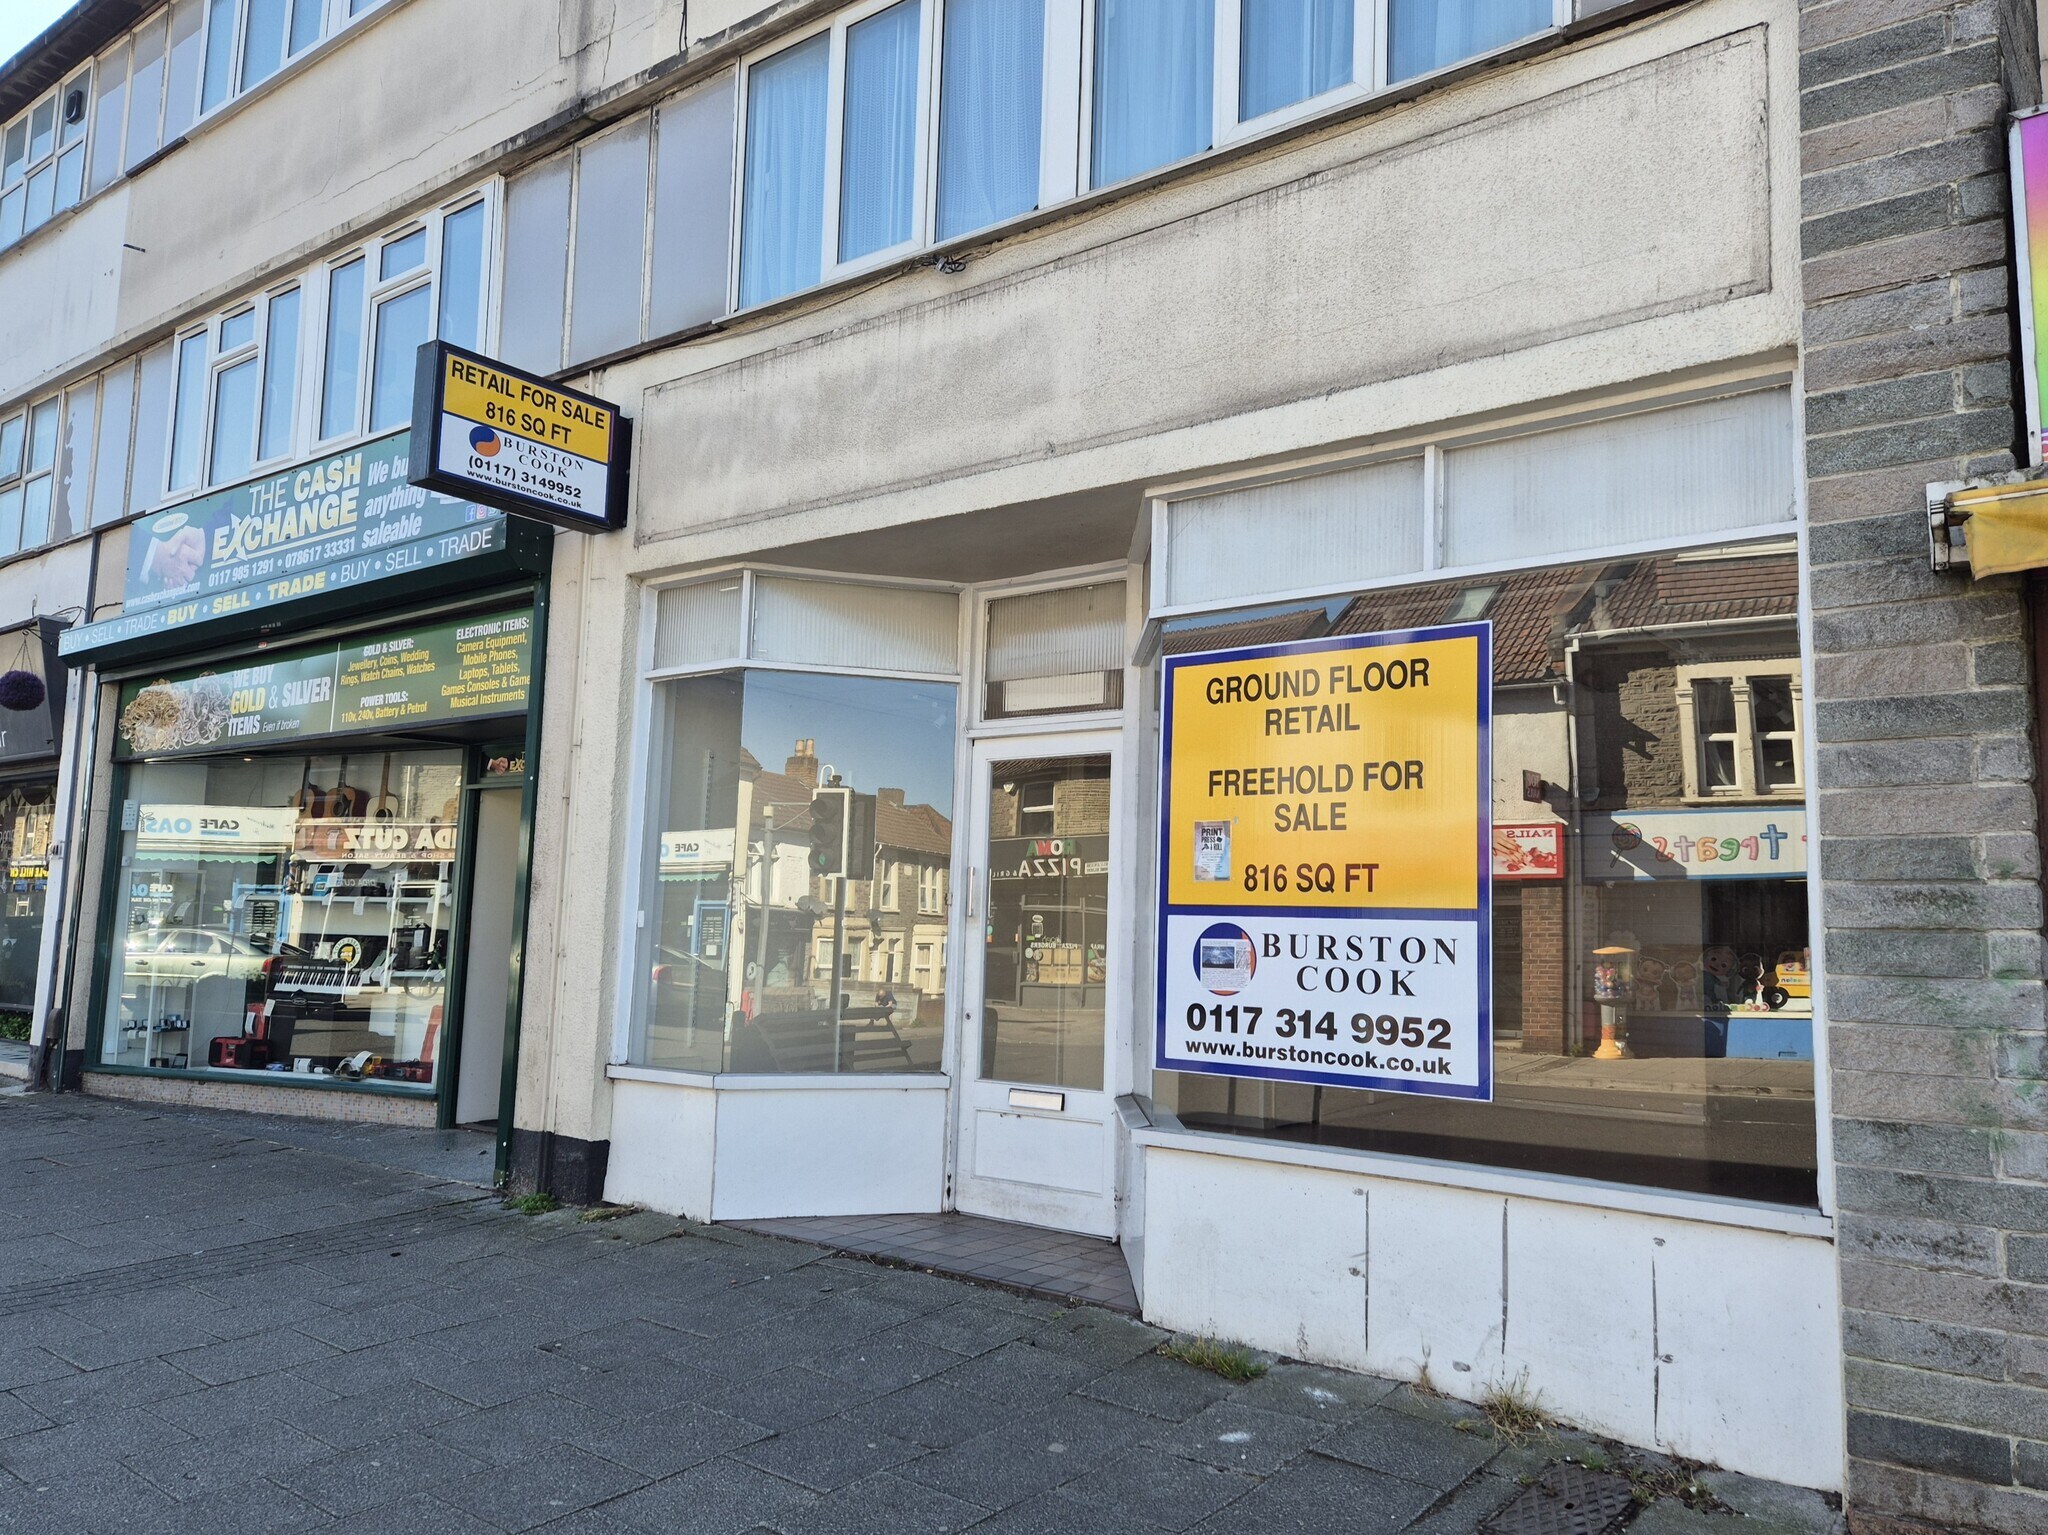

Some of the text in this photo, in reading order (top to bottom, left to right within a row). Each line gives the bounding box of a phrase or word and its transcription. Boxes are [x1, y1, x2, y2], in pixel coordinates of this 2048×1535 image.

[452, 360, 604, 429] RETAIL FOR SALE
[485, 402, 572, 444] 816 SQ FT
[504, 437, 585, 471] BURSTON
[518, 455, 568, 478] COOK
[250, 453, 362, 515] THE CASH
[368, 456, 408, 486] We bu
[469, 455, 582, 498] (0117) 3149952
[364, 484, 426, 518] anything
[467, 470, 582, 508] www.burstoncook.co.uk
[212, 487, 359, 561] EXCHANGE
[362, 513, 422, 549] saleable
[209, 537, 355, 588] 0117 985 1291 078617 33331
[64, 527, 493, 650] BUY SELL TRADE BUY SELL TRADE BUY SELL TRADE
[456, 617, 529, 640] ELECTRONIC ITEMS:
[457, 632, 527, 653] Camera Equipment,
[348, 650, 429, 672] Jewellery, Coins, Wedding
[364, 638, 414, 656] GOLD & SILVER:
[463, 649, 518, 666] Mobile Phones,
[233, 664, 274, 688] WE BUY
[341, 662, 435, 686] Rings, Watch Chains, Watches
[441, 675, 530, 696] Games Consoles & Game
[459, 662, 520, 681] Laptops, Tablets,
[1206, 658, 1430, 704] GROUND FLOOR
[230, 676, 331, 715] GOLD & SILVER
[360, 691, 408, 707] POWER TOOLS:
[376, 706, 399, 718] Battery
[400, 704, 406, 714] &
[407, 701, 427, 714] Petrol
[450, 689, 525, 708] Musical Instruments
[228, 715, 260, 736] ITEMS
[263, 721, 275, 732] Even
[281, 719, 300, 730] broken
[1265, 703, 1360, 736] RETAIL
[1208, 760, 1424, 797] FREEHOLD FOR
[1201, 828, 1223, 836] PRINT
[1274, 802, 1347, 832] SALE
[1244, 863, 1379, 893] 816 SQ FT
[1261, 932, 1459, 965] BURSTON
[1297, 965, 1417, 997] COOK
[1186, 1002, 1452, 1050] 0117 314 9952
[1186, 1040, 1452, 1076] www.burstoncook.co.uk
